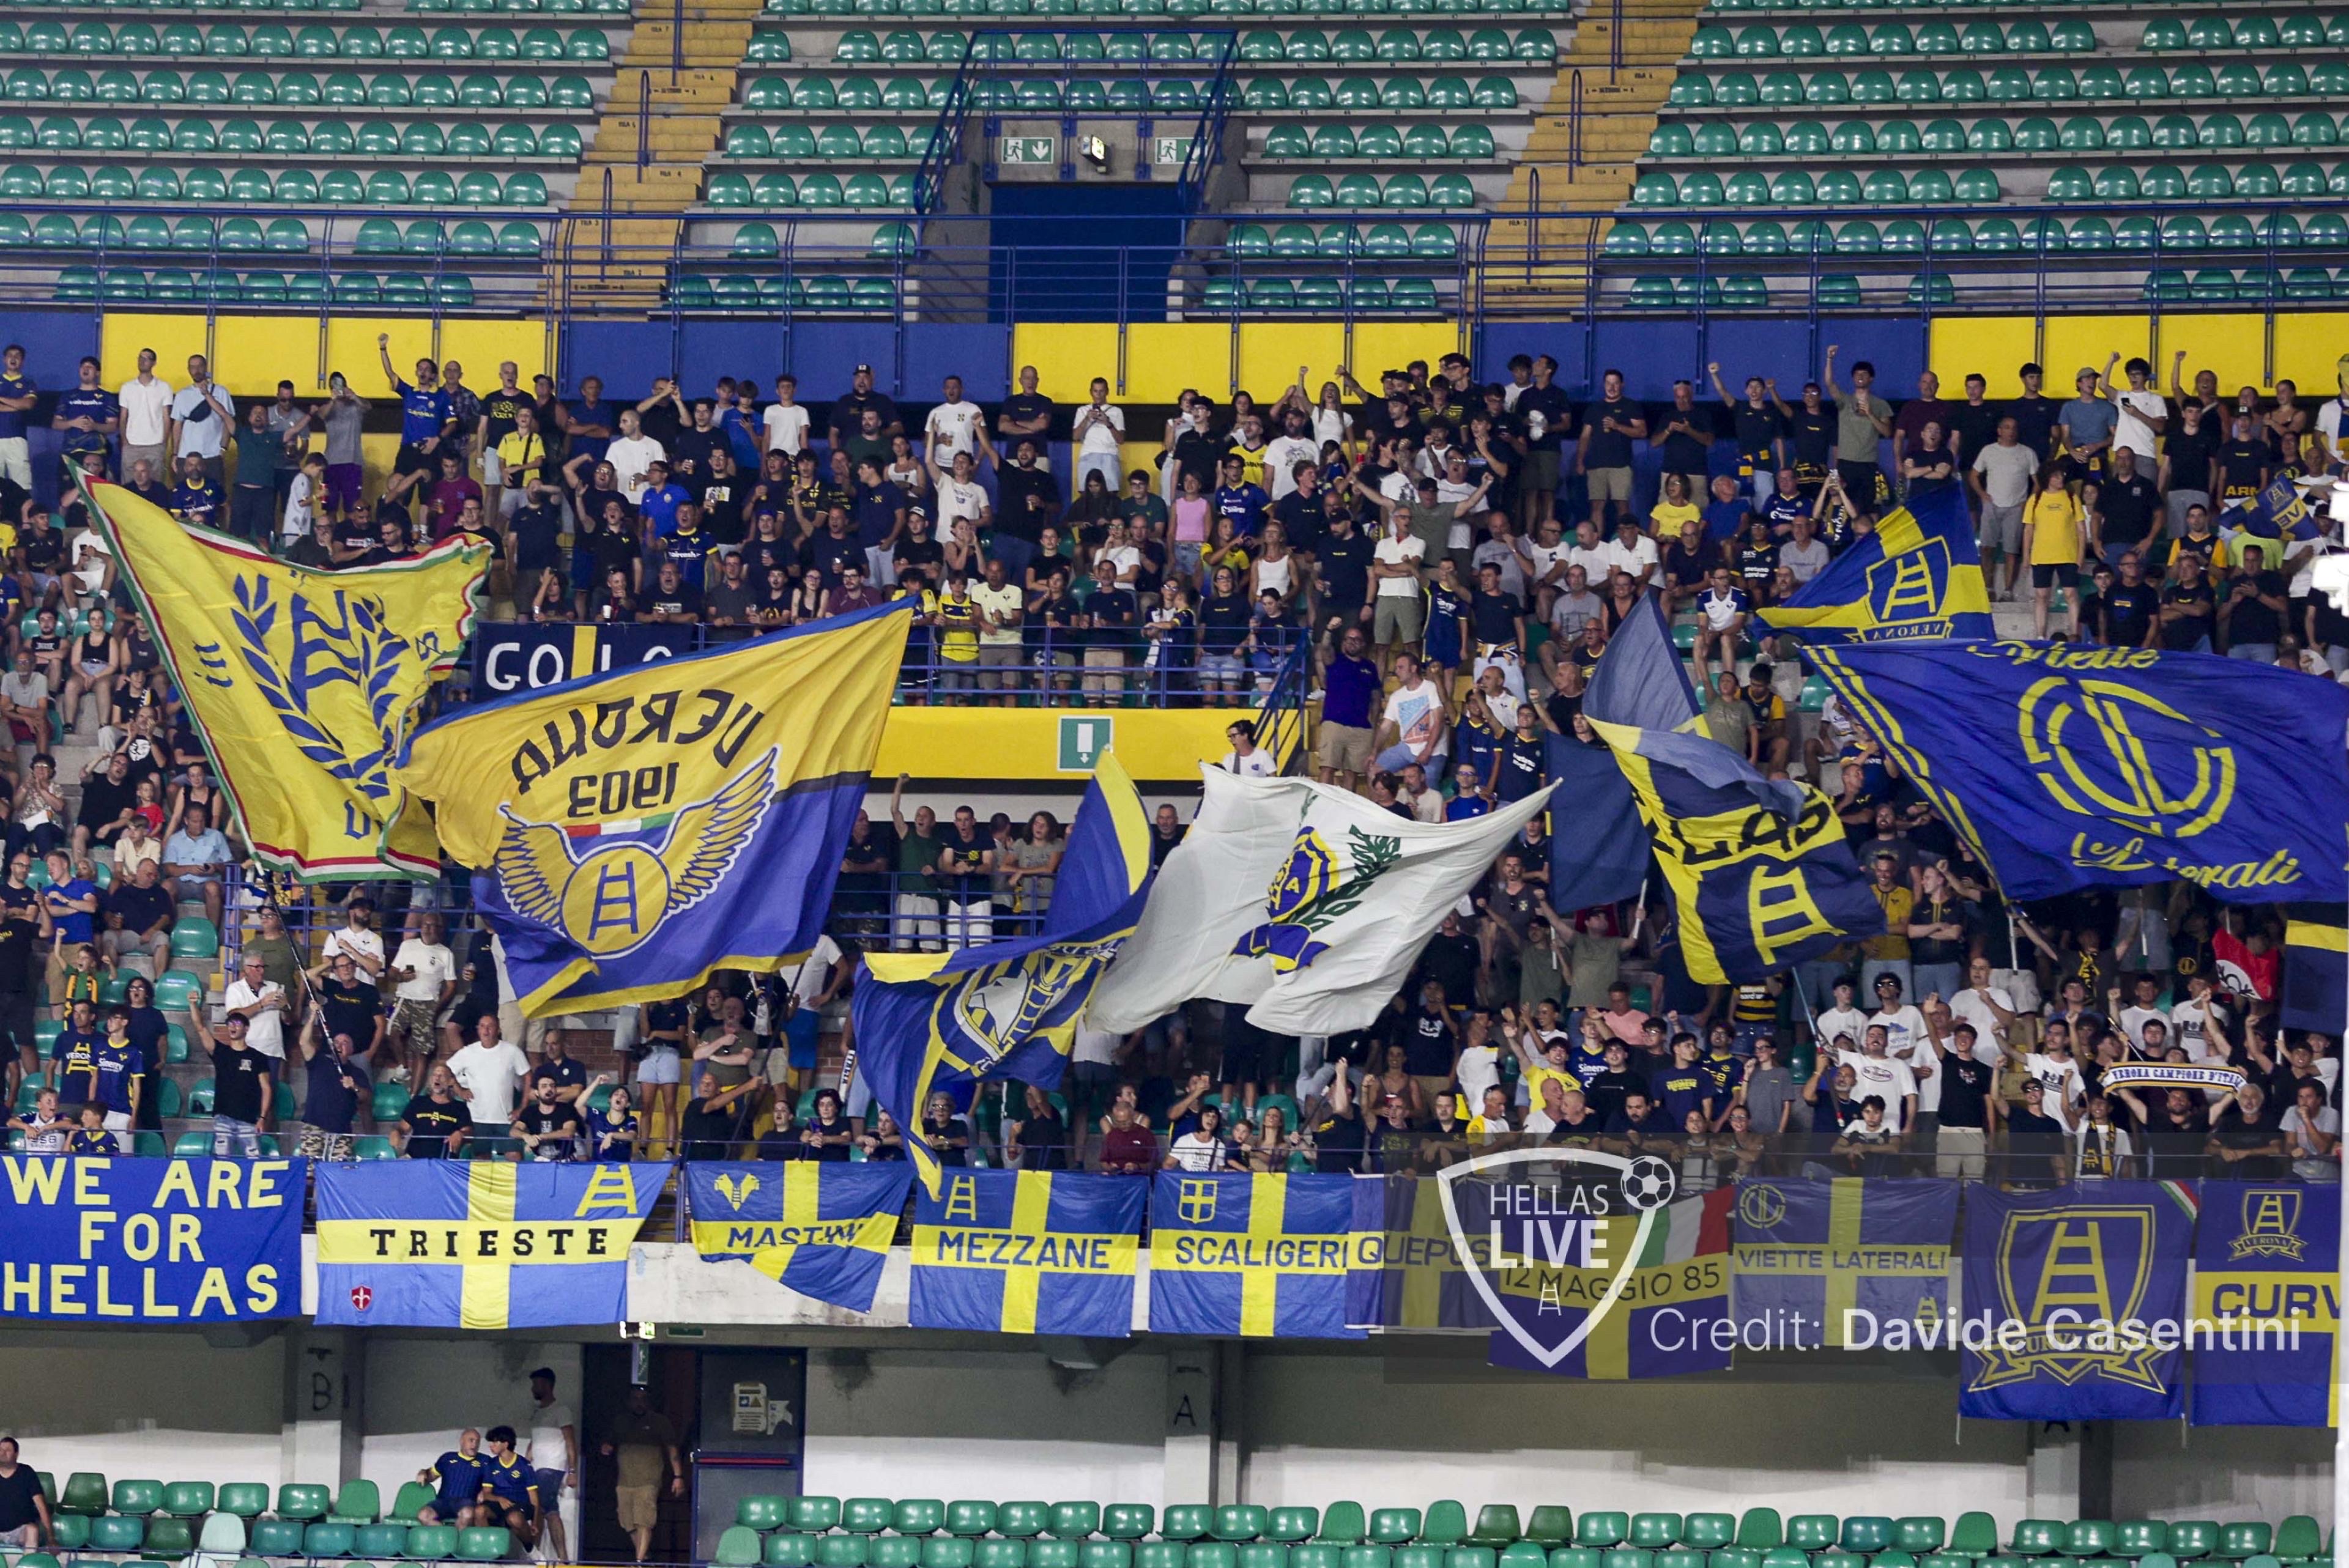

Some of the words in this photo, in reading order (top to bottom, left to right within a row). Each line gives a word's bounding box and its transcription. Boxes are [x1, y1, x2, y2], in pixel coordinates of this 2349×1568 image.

[2, 1156, 111, 1205] WE
[152, 1159, 290, 1210] ARE
[80, 1211, 206, 1263] FOR
[369, 1227, 608, 1257] TRIESTE
[937, 1230, 1113, 1270] MEZZANE
[1739, 1249, 1822, 1268] VIETTE
[1832, 1251, 1946, 1270] LATERALI
[2, 1262, 278, 1317] HELLAS
[1539, 1270, 1671, 1301] MAGGIO
[1683, 1262, 1720, 1292] 85
